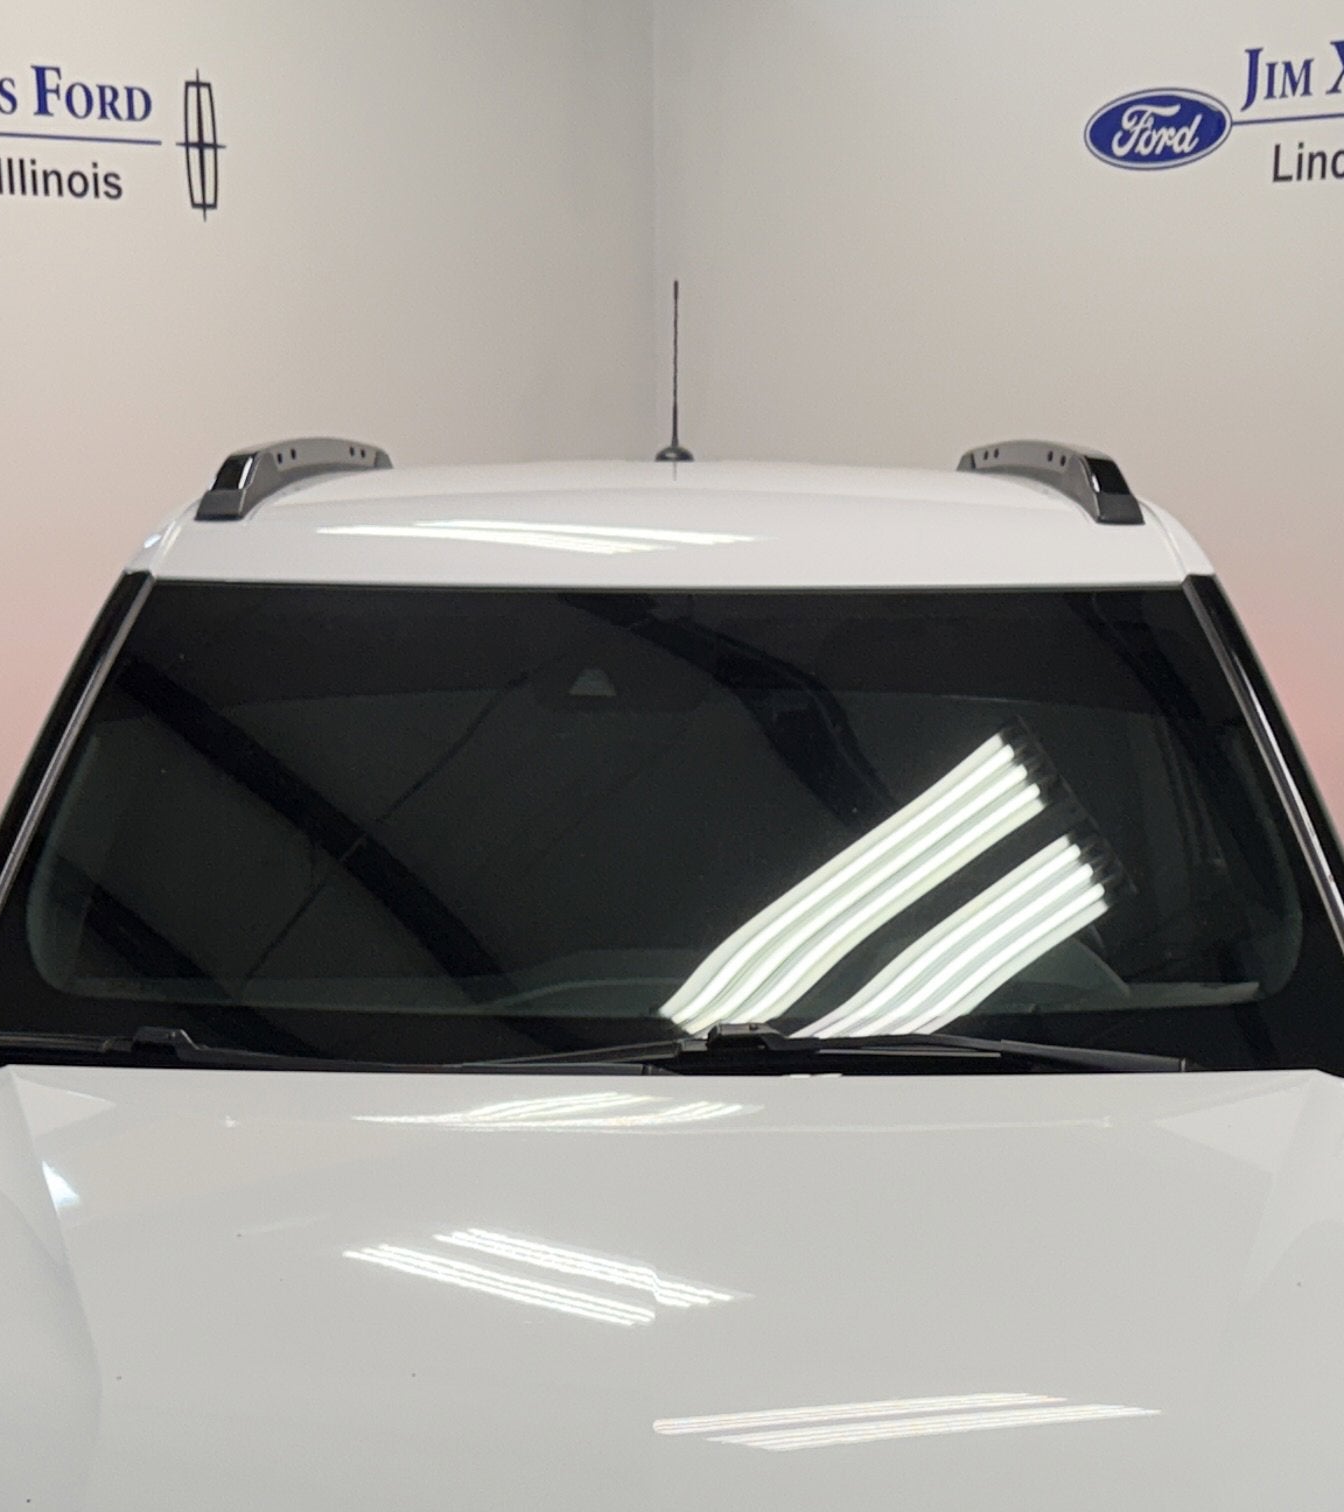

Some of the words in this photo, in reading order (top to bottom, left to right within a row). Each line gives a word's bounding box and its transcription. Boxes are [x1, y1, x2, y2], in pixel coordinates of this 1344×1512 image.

[30, 64, 153, 122] FORD
[1240, 47, 1315, 113] JIM
[1110, 104, 1200, 158] Ford
